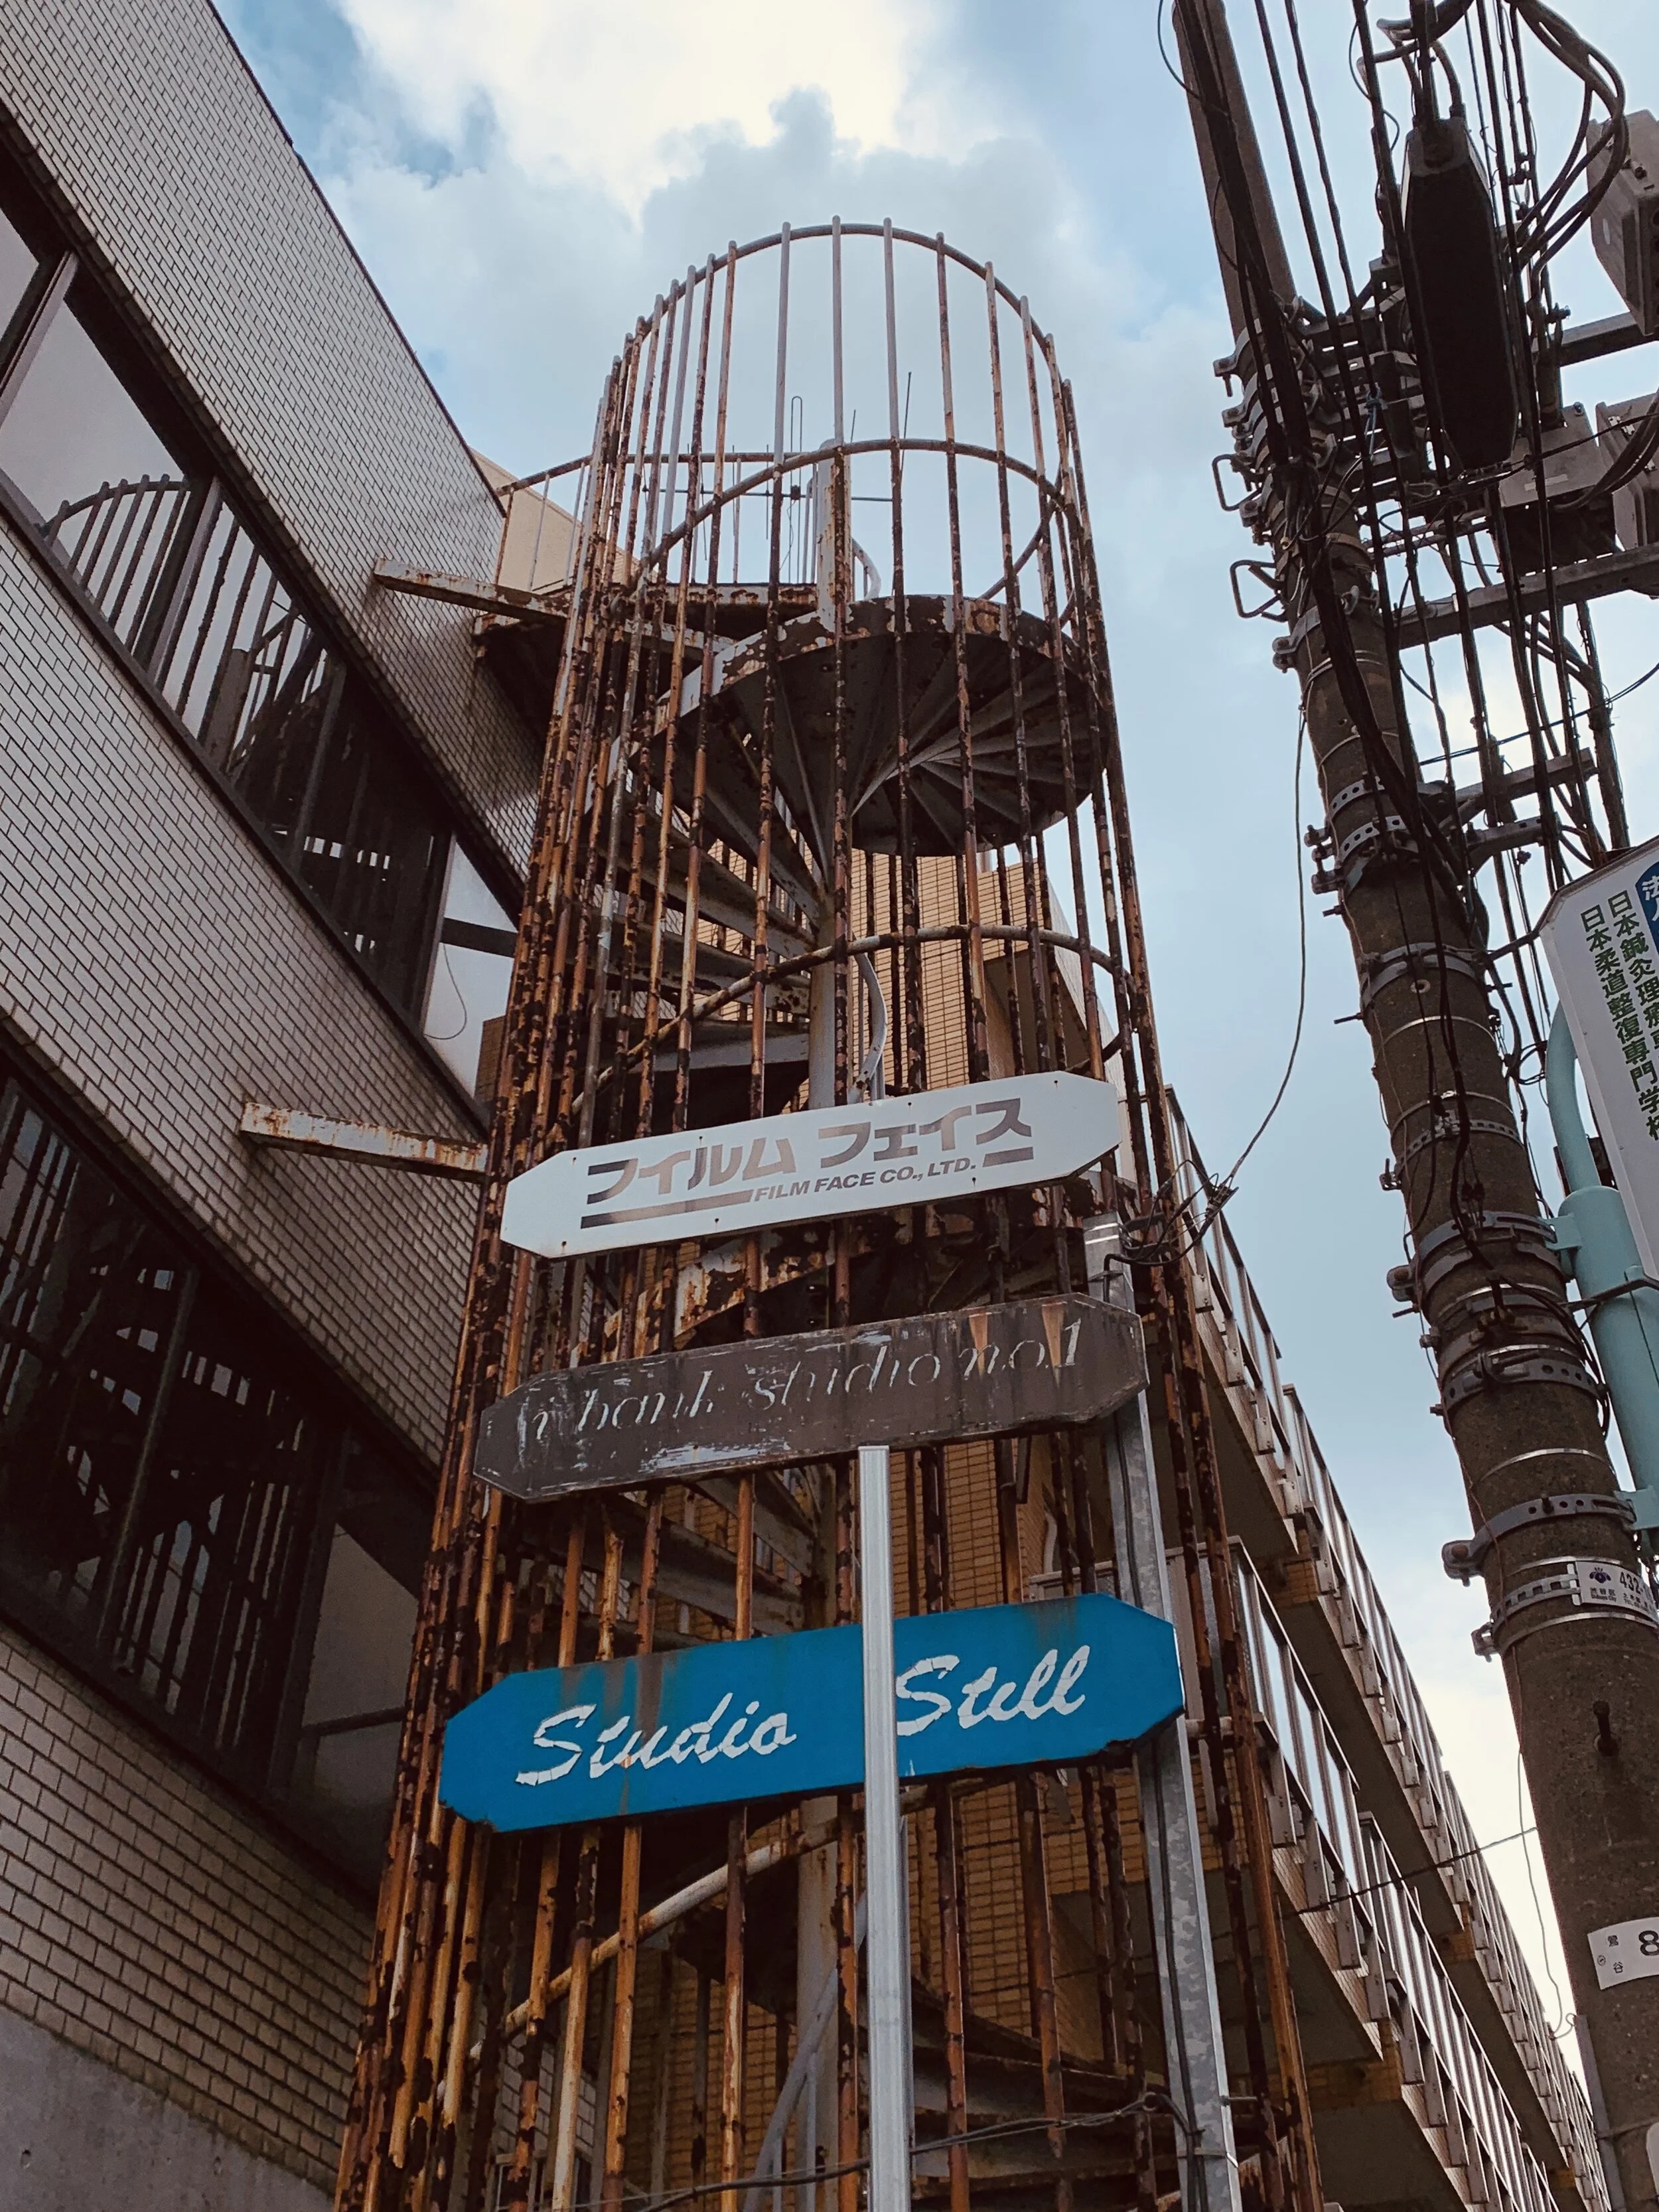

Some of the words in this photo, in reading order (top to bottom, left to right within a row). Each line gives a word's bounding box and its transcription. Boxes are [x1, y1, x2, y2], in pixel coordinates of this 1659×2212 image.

[752, 1179, 810, 1203] FILM
[814, 1171, 875, 1193] FACE
[927, 1157, 977, 1177] LTD.
[515, 1692, 796, 1786] Studio
[895, 1645, 1090, 1736] Still
